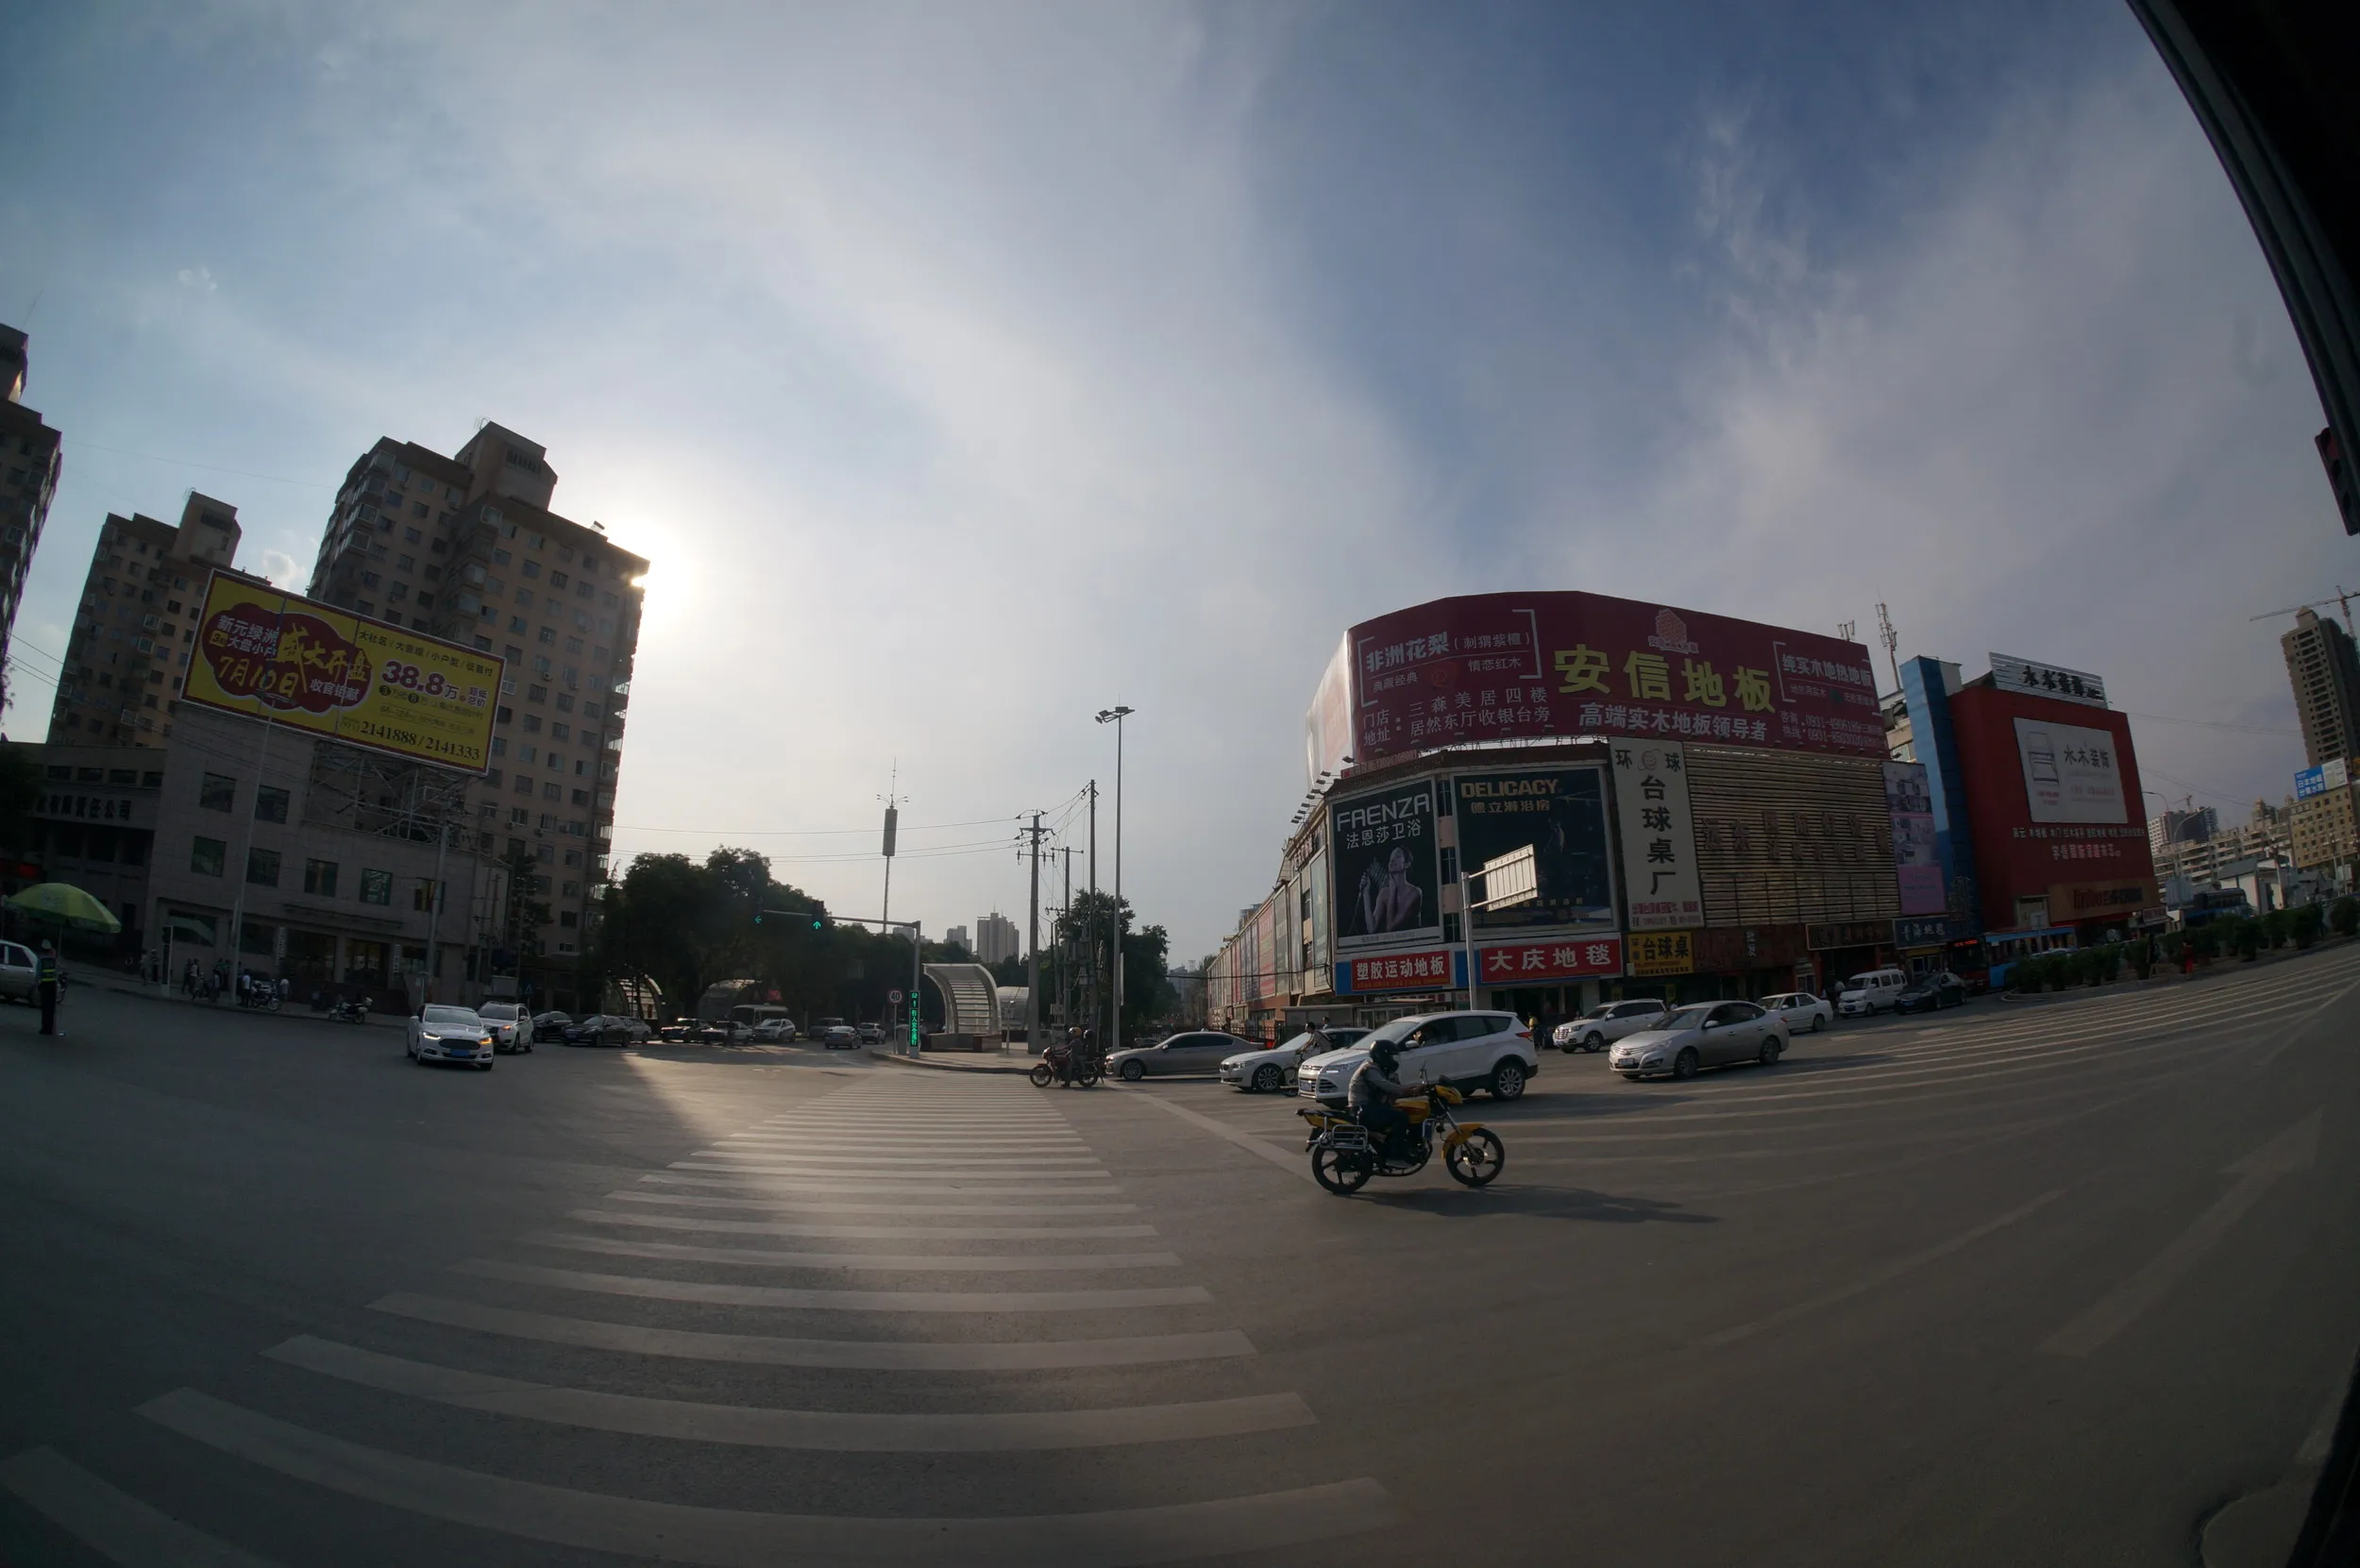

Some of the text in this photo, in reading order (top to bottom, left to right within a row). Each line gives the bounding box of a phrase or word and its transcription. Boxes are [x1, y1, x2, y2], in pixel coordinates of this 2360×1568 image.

[216, 615, 279, 644] 新元绿洲
[1367, 631, 1450, 672] 非洲花梨
[218, 655, 298, 699] 7月10日
[1554, 643, 1776, 714] 安信地板
[1410, 706, 1551, 737] 居然东厅收银台旁
[1579, 702, 1767, 742] 高端实木地板领导者
[361, 721, 417, 746] 2141888
[426, 737, 480, 761] 2141333
[1460, 779, 1559, 799] DELICACY
[36, 793, 132, 821] 有限责任公司
[1337, 792, 1430, 832] FAENZA
[1346, 818, 1422, 850] 法恩莎卫浴
[1641, 775, 1677, 896] 台球桌厂
[1488, 944, 1613, 972] 大庆地毯
[1642, 936, 1690, 960] 台球桌
[1356, 955, 1445, 981] 塑胶运动地板
[890, 992, 900, 1001] 40
